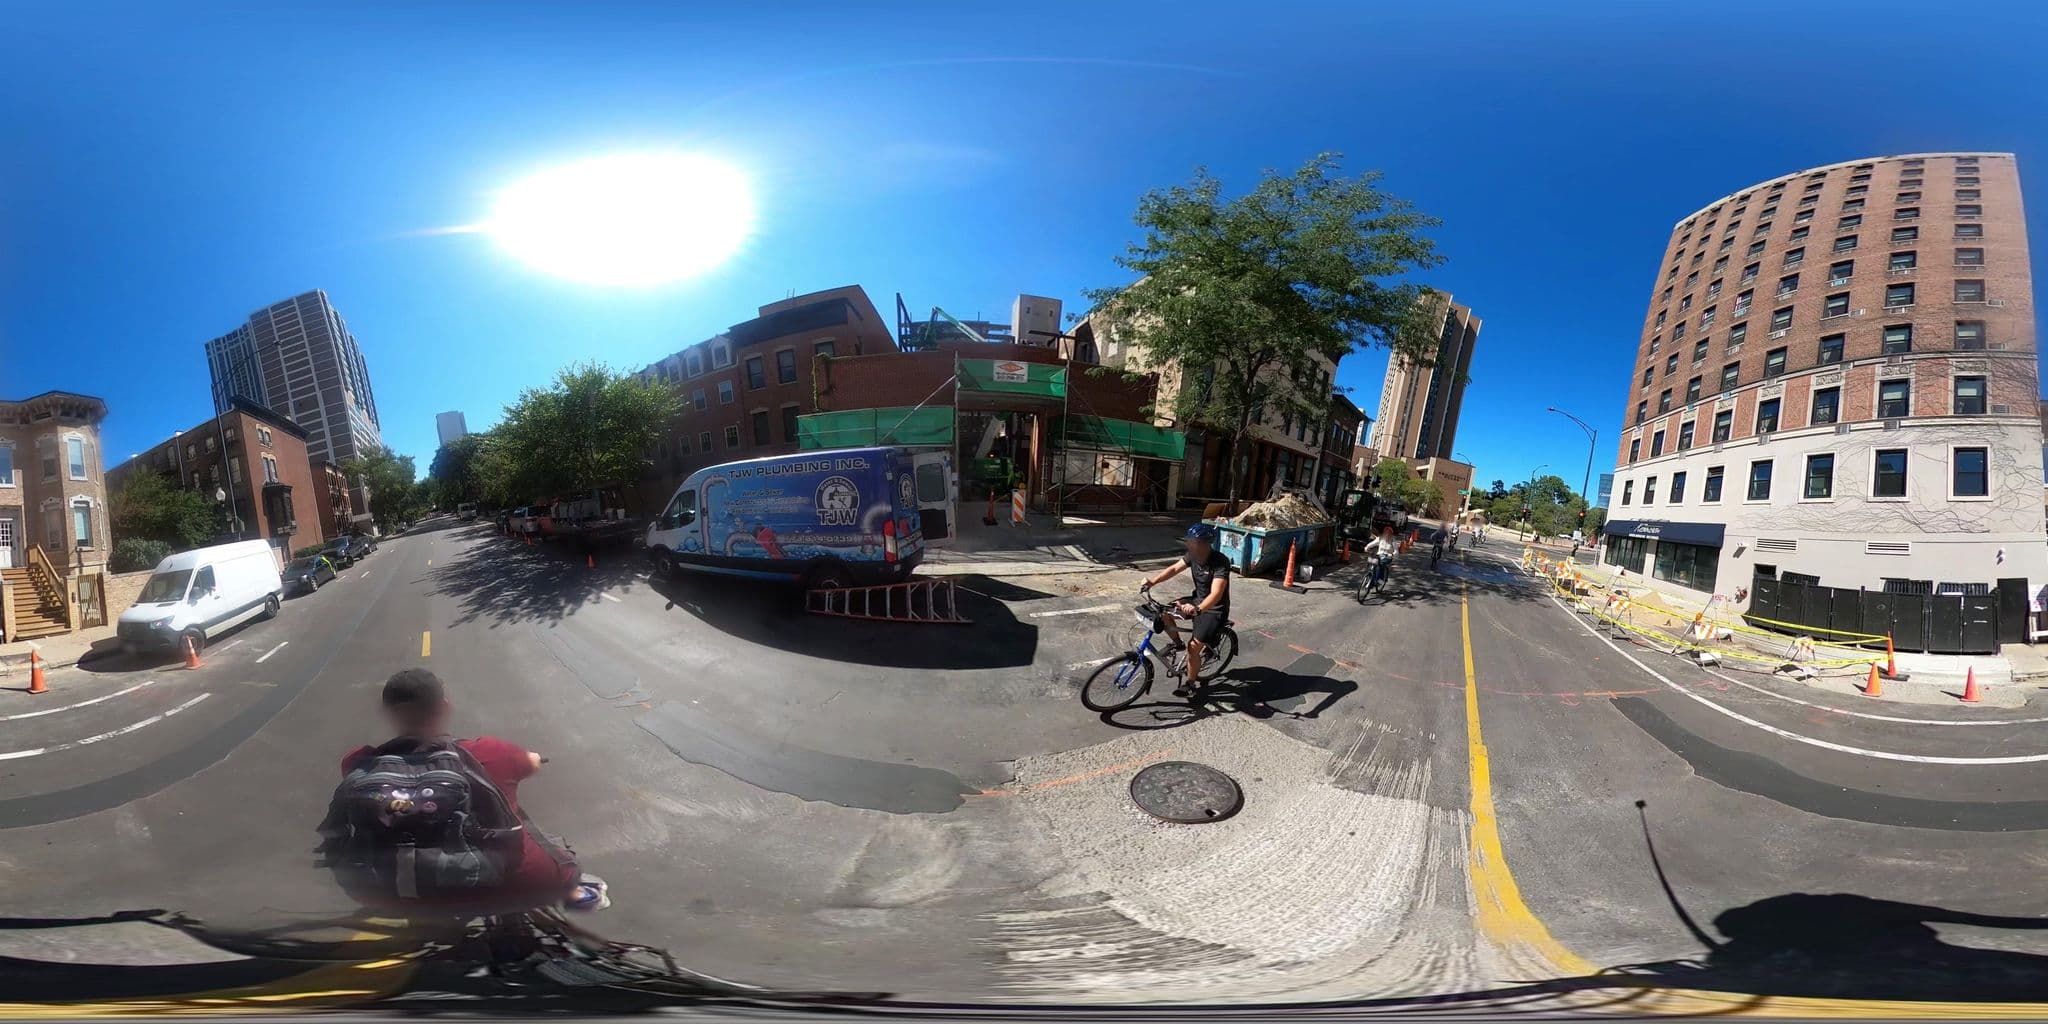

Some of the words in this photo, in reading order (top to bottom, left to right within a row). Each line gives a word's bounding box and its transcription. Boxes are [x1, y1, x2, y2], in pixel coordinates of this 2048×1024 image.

[729, 469, 752, 478] TJW
[756, 460, 831, 476] PLUMBING
[836, 457, 870, 471] INC.
[817, 509, 857, 526] TJW
